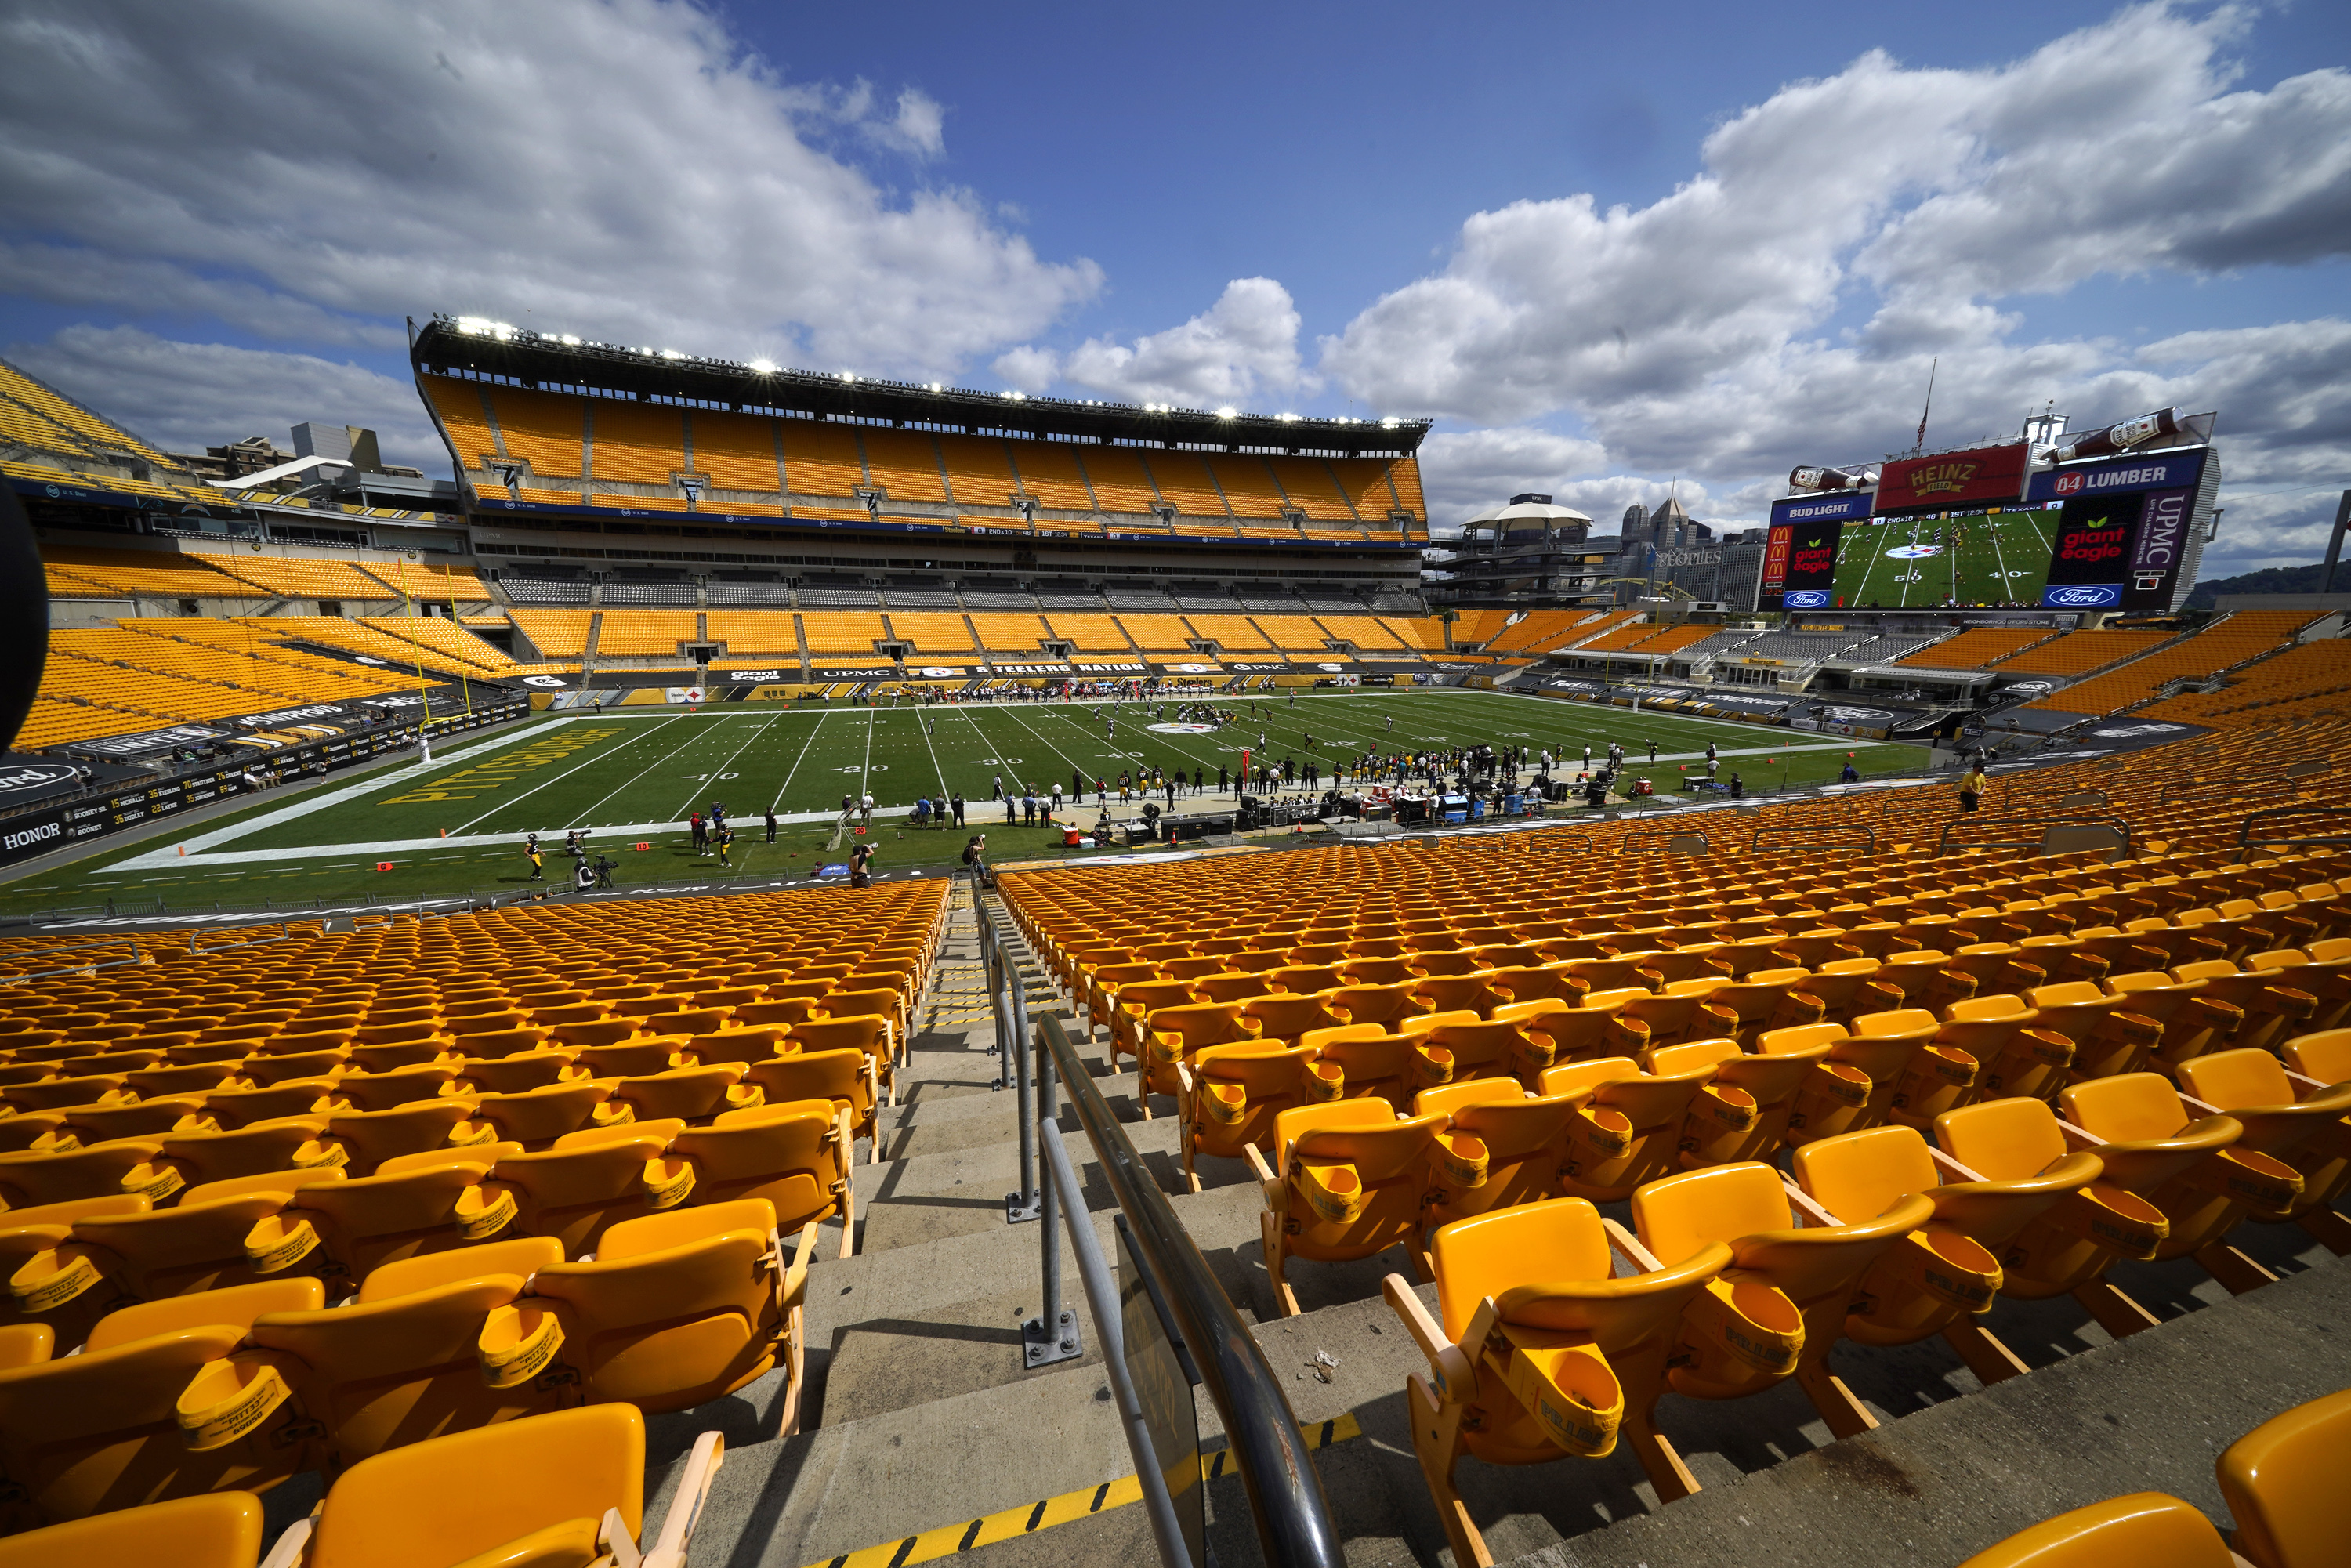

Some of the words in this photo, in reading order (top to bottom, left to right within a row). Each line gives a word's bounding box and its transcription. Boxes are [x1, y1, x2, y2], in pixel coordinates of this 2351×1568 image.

[1911, 464, 1976, 487] HEINZ
[2056, 476, 2081, 491] 84
[2086, 466, 2167, 488] LUMBER
[1929, 483, 1949, 491] FIELD
[1789, 507, 1813, 518] BUD
[1814, 504, 1849, 515] LIGHT
[2143, 512, 2154, 537] CHANGING
[2146, 495, 2185, 564] UPMC
[2064, 527, 2125, 549] giant
[1658, 550, 1722, 567] PEOPLES
[1795, 547, 1831, 563] giant
[2061, 544, 2121, 562] eagle
[2136, 538, 2146, 565] MEDICINE
[1793, 559, 1830, 574] eagle
[1797, 593, 1820, 606] Ford
[2059, 588, 2103, 603] Ford
[1177, 677, 1212, 686] Steelers
[1472, 677, 1482, 687] 33
[1550, 679, 1598, 690] FedEx
[1862, 729, 1873, 737] 33
[101, 734, 192, 752] UNITE
[376, 727, 627, 806] PITTSBURGH
[843, 765, 889, 773] 20
[216, 772, 226, 781] 75
[694, 773, 740, 781] 10
[182, 780, 192, 790] 70
[219, 785, 228, 794] 59
[148, 789, 158, 799] 35
[185, 794, 195, 804] 35
[194, 791, 216, 802] JOHNSON
[111, 798, 120, 809] 15
[120, 795, 145, 807] MCNALLY
[151, 804, 161, 814] 22
[161, 802, 178, 811] LAYNE
[74, 808, 98, 820] ROONEY
[113, 815, 124, 824] 35
[124, 811, 145, 822] DUDLEY
[3, 823, 61, 850] HONOR
[77, 824, 103, 836] ROONEY
[488, 1219, 505, 1232] 69050
[285, 1248, 306, 1263] 69050
[53, 1287, 79, 1303] 69050
[527, 1353, 549, 1374] 69050
[227, 1396, 256, 1421] ASSISTANCE
[256, 1388, 266, 1397] TEXT
[208, 1429, 224, 1438] YOUR
[224, 1414, 250, 1433] LOCATION
[234, 1410, 263, 1436] 69050
